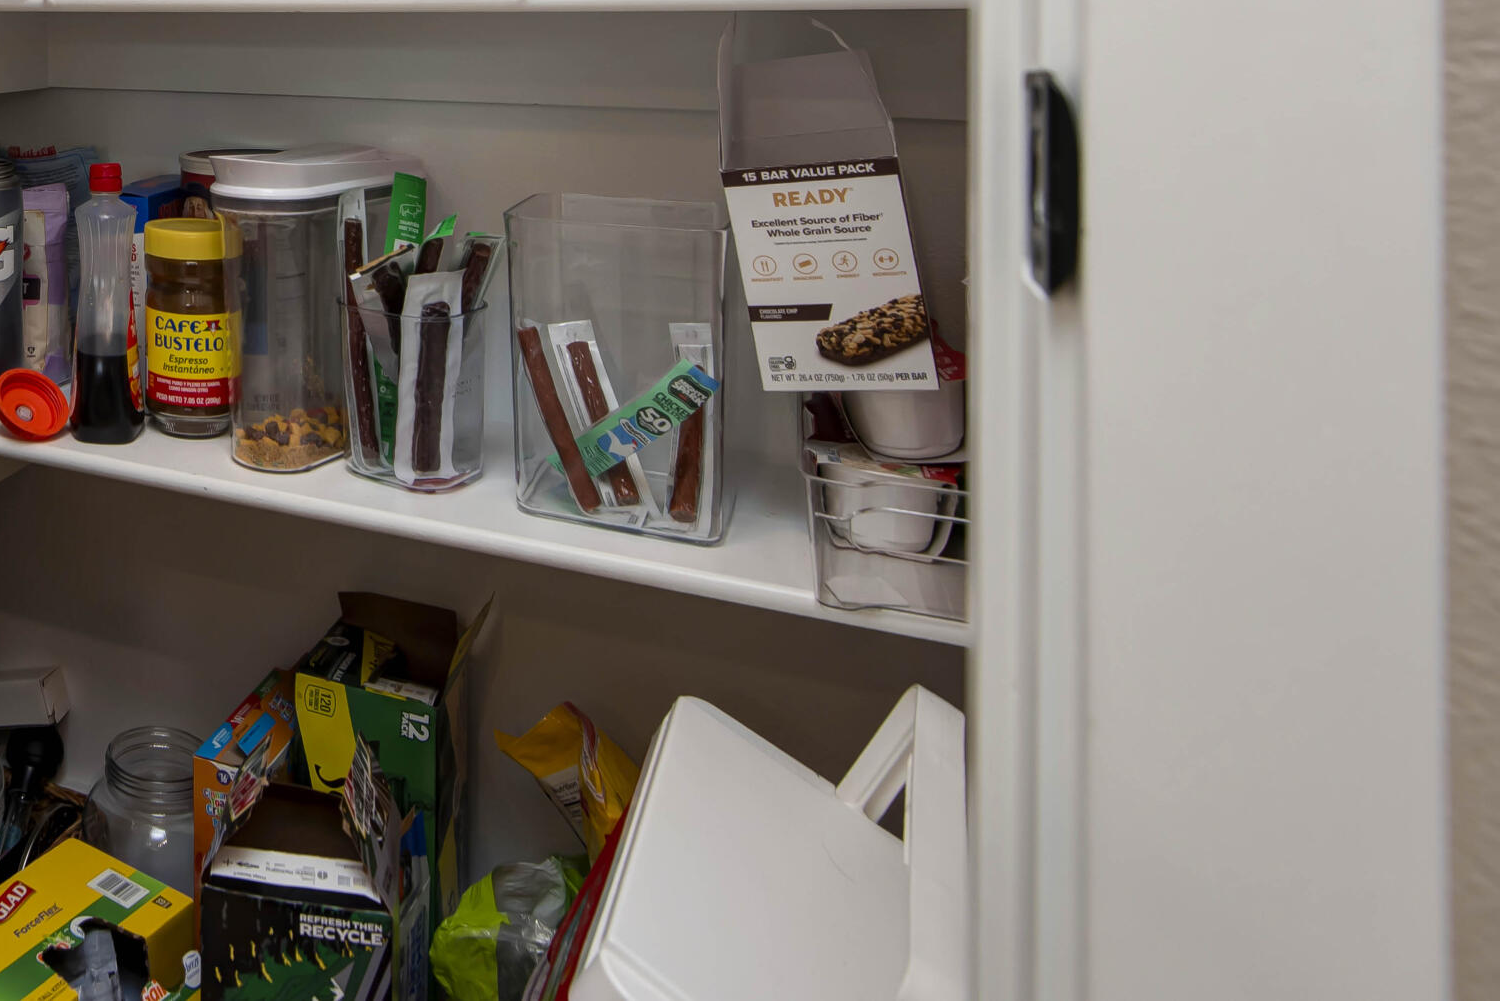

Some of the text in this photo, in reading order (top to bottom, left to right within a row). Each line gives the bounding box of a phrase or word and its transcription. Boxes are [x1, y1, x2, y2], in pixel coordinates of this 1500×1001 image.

[742, 162, 876, 181] 15 BAR VALUE PACK
[772, 187, 849, 208] READY
[751, 218, 798, 228] Excellent
[800, 216, 837, 225] Source
[839, 214, 850, 223] of
[767, 224, 871, 238] Whole Grain Source
[155, 333, 224, 352] BUSTELO
[163, 362, 215, 374] Instantáneo
[169, 354, 208, 365] Espresso
[771, 374, 784, 382] NET
[825, 373, 845, 383] (750g)
[867, 373, 876, 381] OZ
[877, 373, 894, 382] (50g)
[895, 373, 911, 381] PER
[156, 392, 168, 400] PESO
[168, 395, 182, 404] NETO
[639, 408, 672, 432] 50
[320, 692, 331, 713] 120
[401, 712, 409, 737] PACK
[408, 712, 429, 742] 12
[13, 903, 60, 938] ForceFlex
[300, 913, 383, 932] REFRESH THEN
[300, 924, 383, 947] RECYCLE
